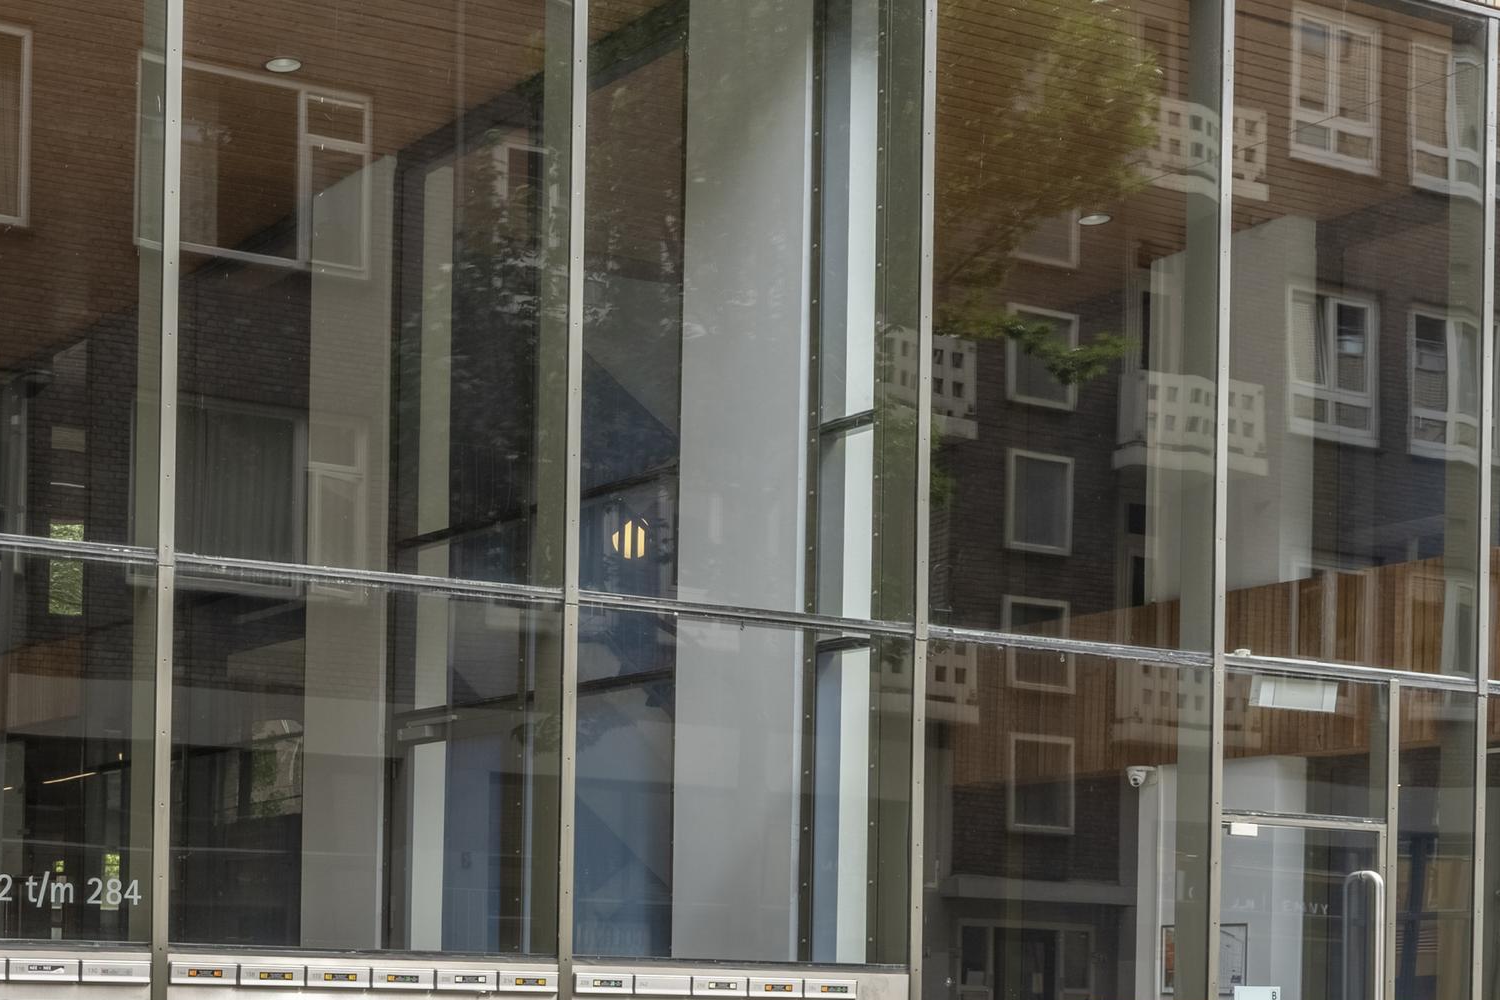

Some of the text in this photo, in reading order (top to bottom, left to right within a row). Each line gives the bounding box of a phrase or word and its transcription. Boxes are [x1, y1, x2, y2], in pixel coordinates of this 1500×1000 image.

[25, 871, 74, 907] t/m
[86, 877, 142, 906] 284
[1271, 991, 1277, 1000] B
